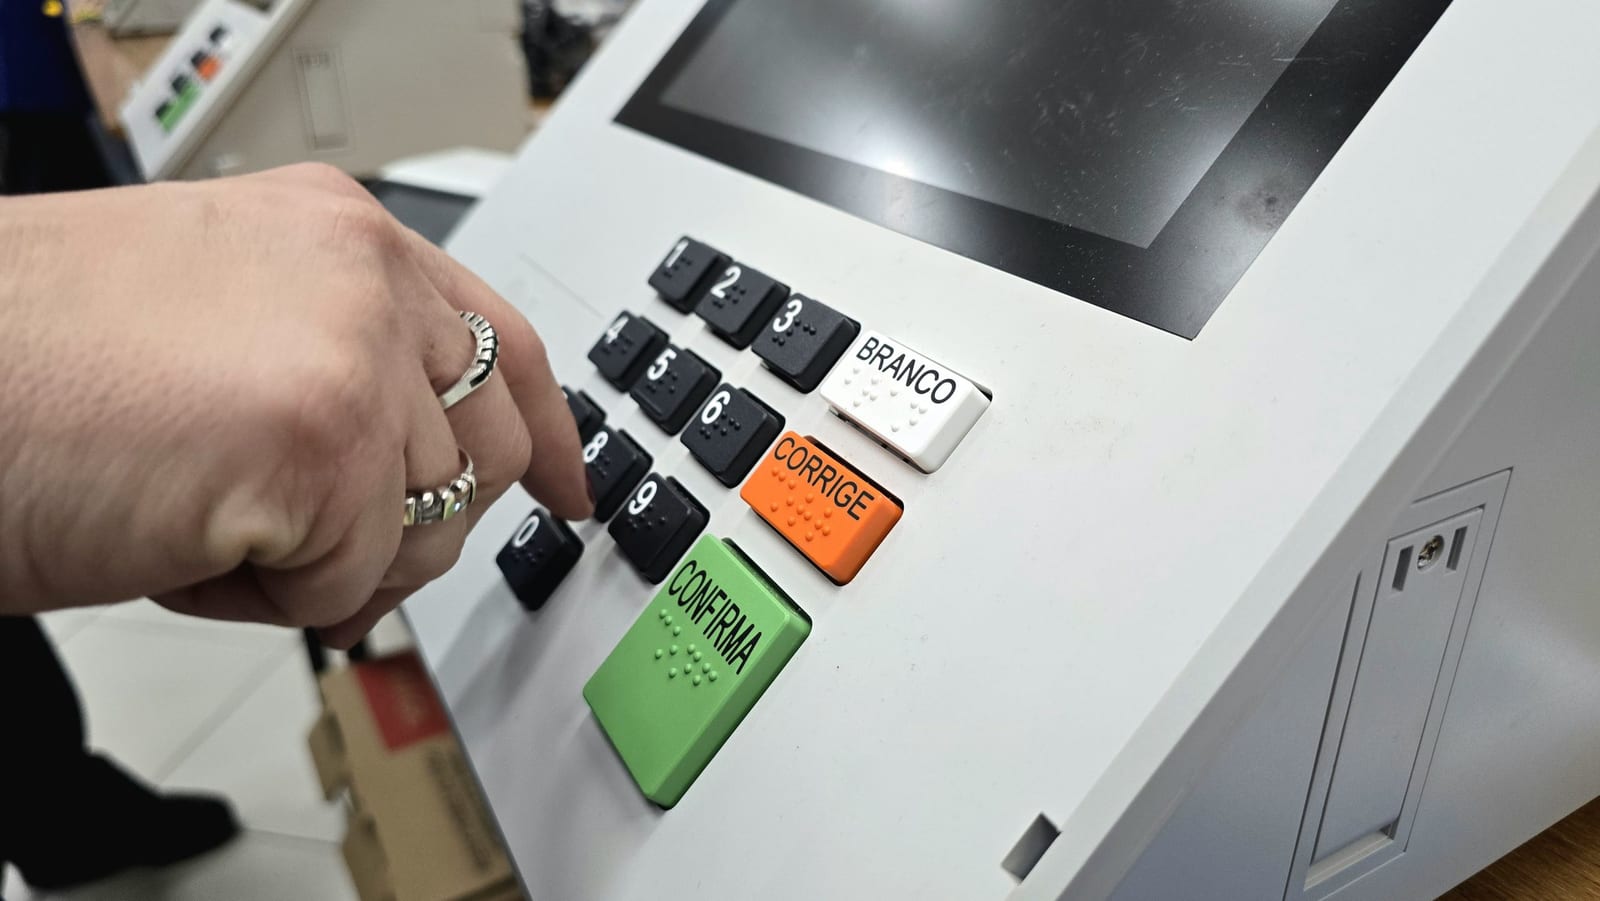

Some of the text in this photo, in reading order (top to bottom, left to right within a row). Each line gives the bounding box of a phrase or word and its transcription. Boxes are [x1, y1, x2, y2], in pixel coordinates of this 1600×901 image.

[665, 240, 689, 268] 1
[710, 266, 742, 298] 2
[605, 316, 630, 344] 4
[772, 299, 803, 333] 3
[647, 348, 677, 381] 5
[856, 336, 957, 405] BRANCO
[701, 390, 731, 424] 6
[583, 430, 609, 463] 8
[773, 437, 875, 521] CORRIGE
[628, 480, 658, 515] 9
[512, 514, 540, 548] 0
[668, 559, 763, 675] CONFIRMA
